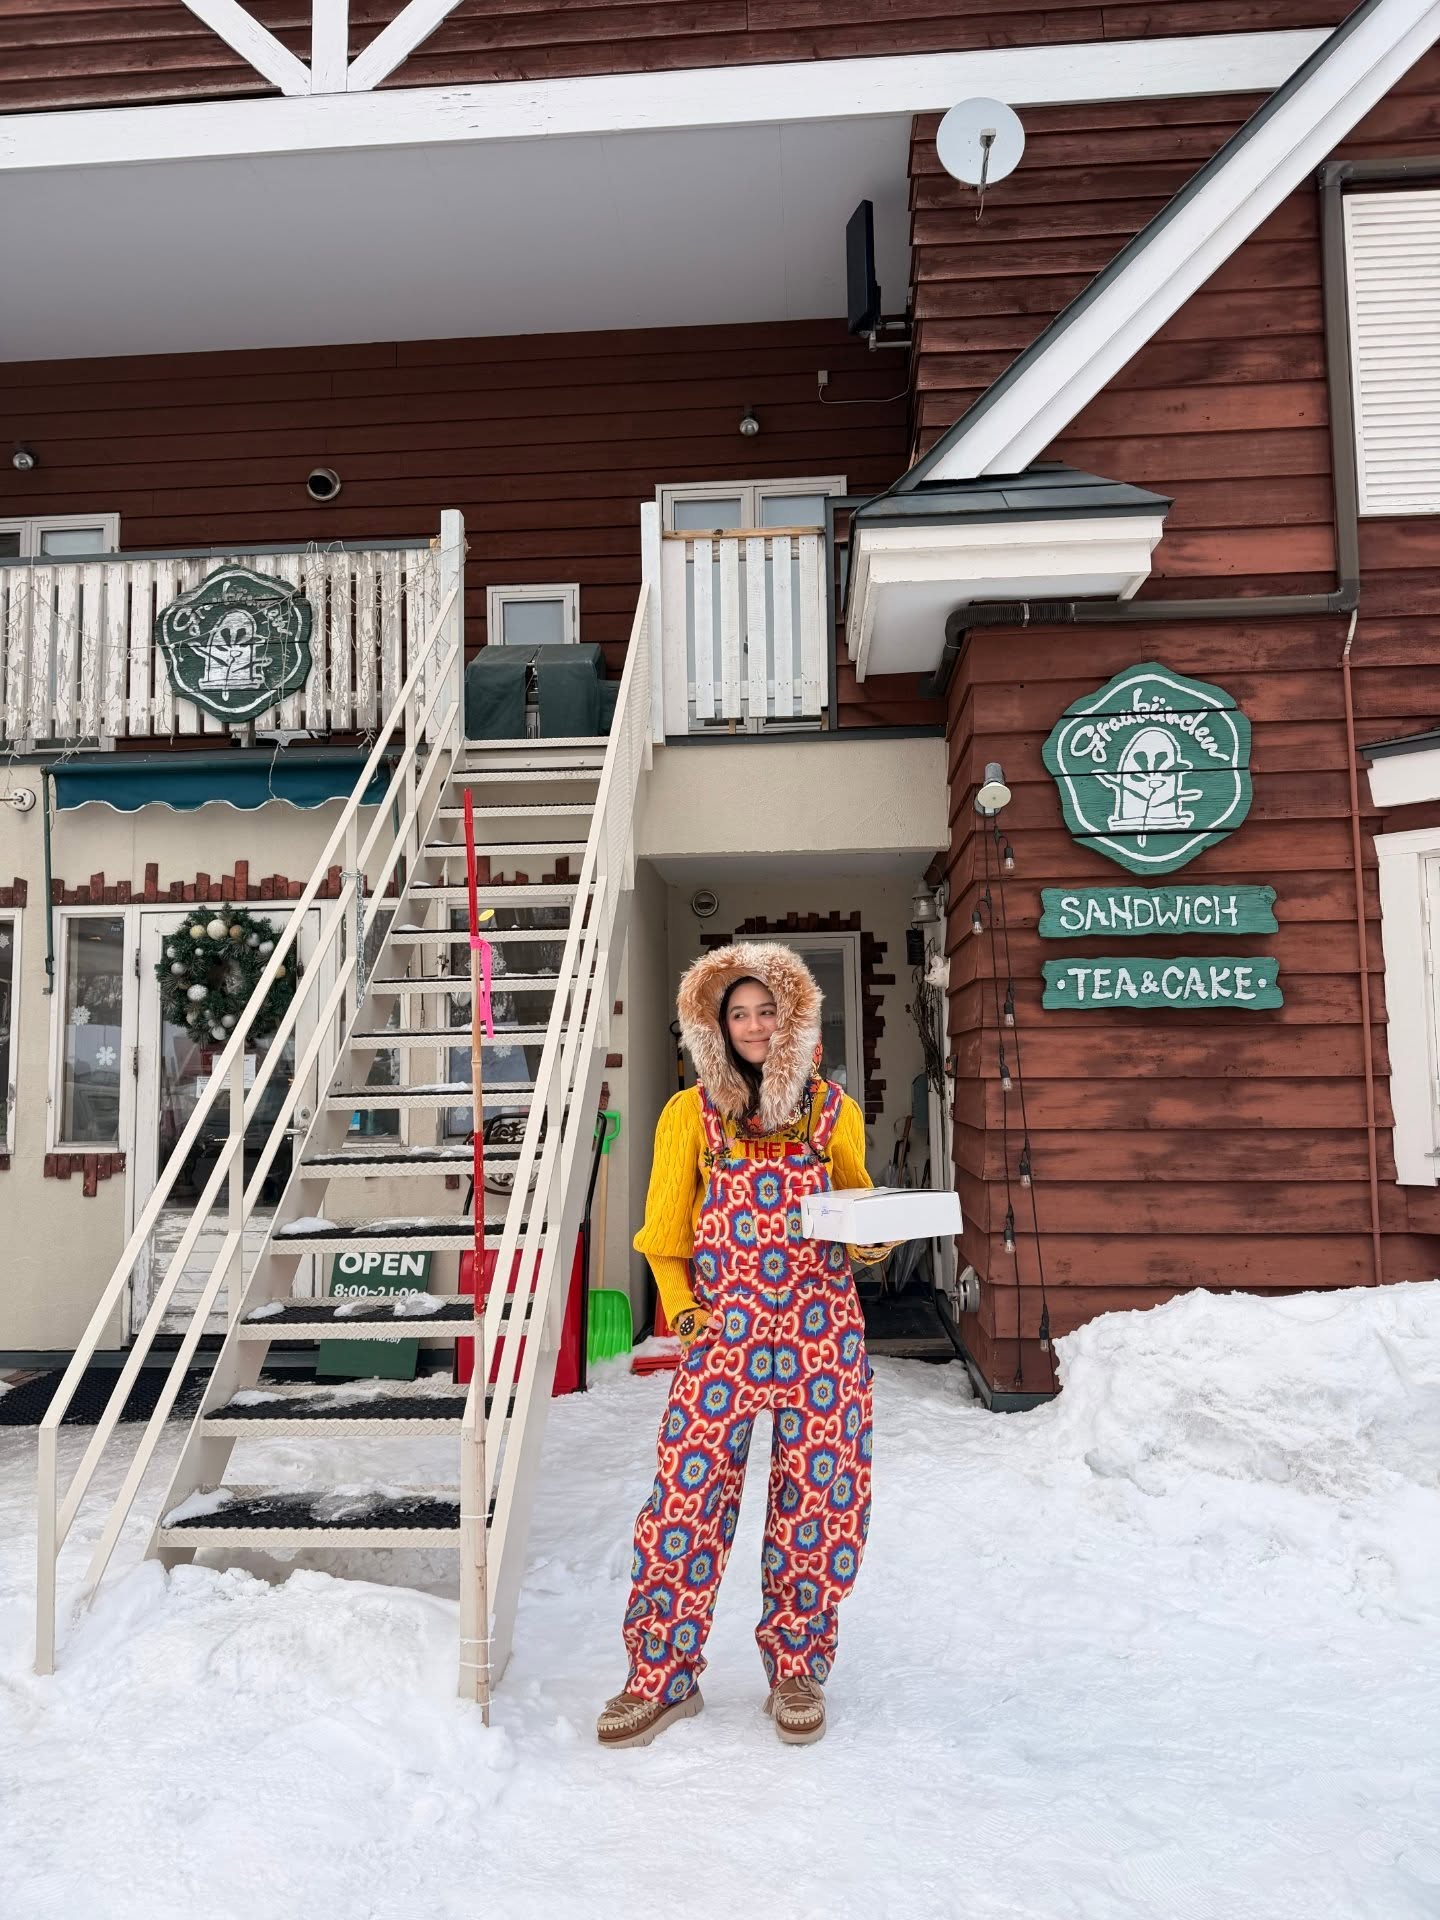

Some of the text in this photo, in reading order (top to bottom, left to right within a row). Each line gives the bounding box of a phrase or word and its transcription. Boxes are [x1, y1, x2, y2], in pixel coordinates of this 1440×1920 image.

[1070, 688, 1229, 763] Graubünden
[740, 1140, 781, 1159] THE
[339, 1252, 425, 1276] OPEN
